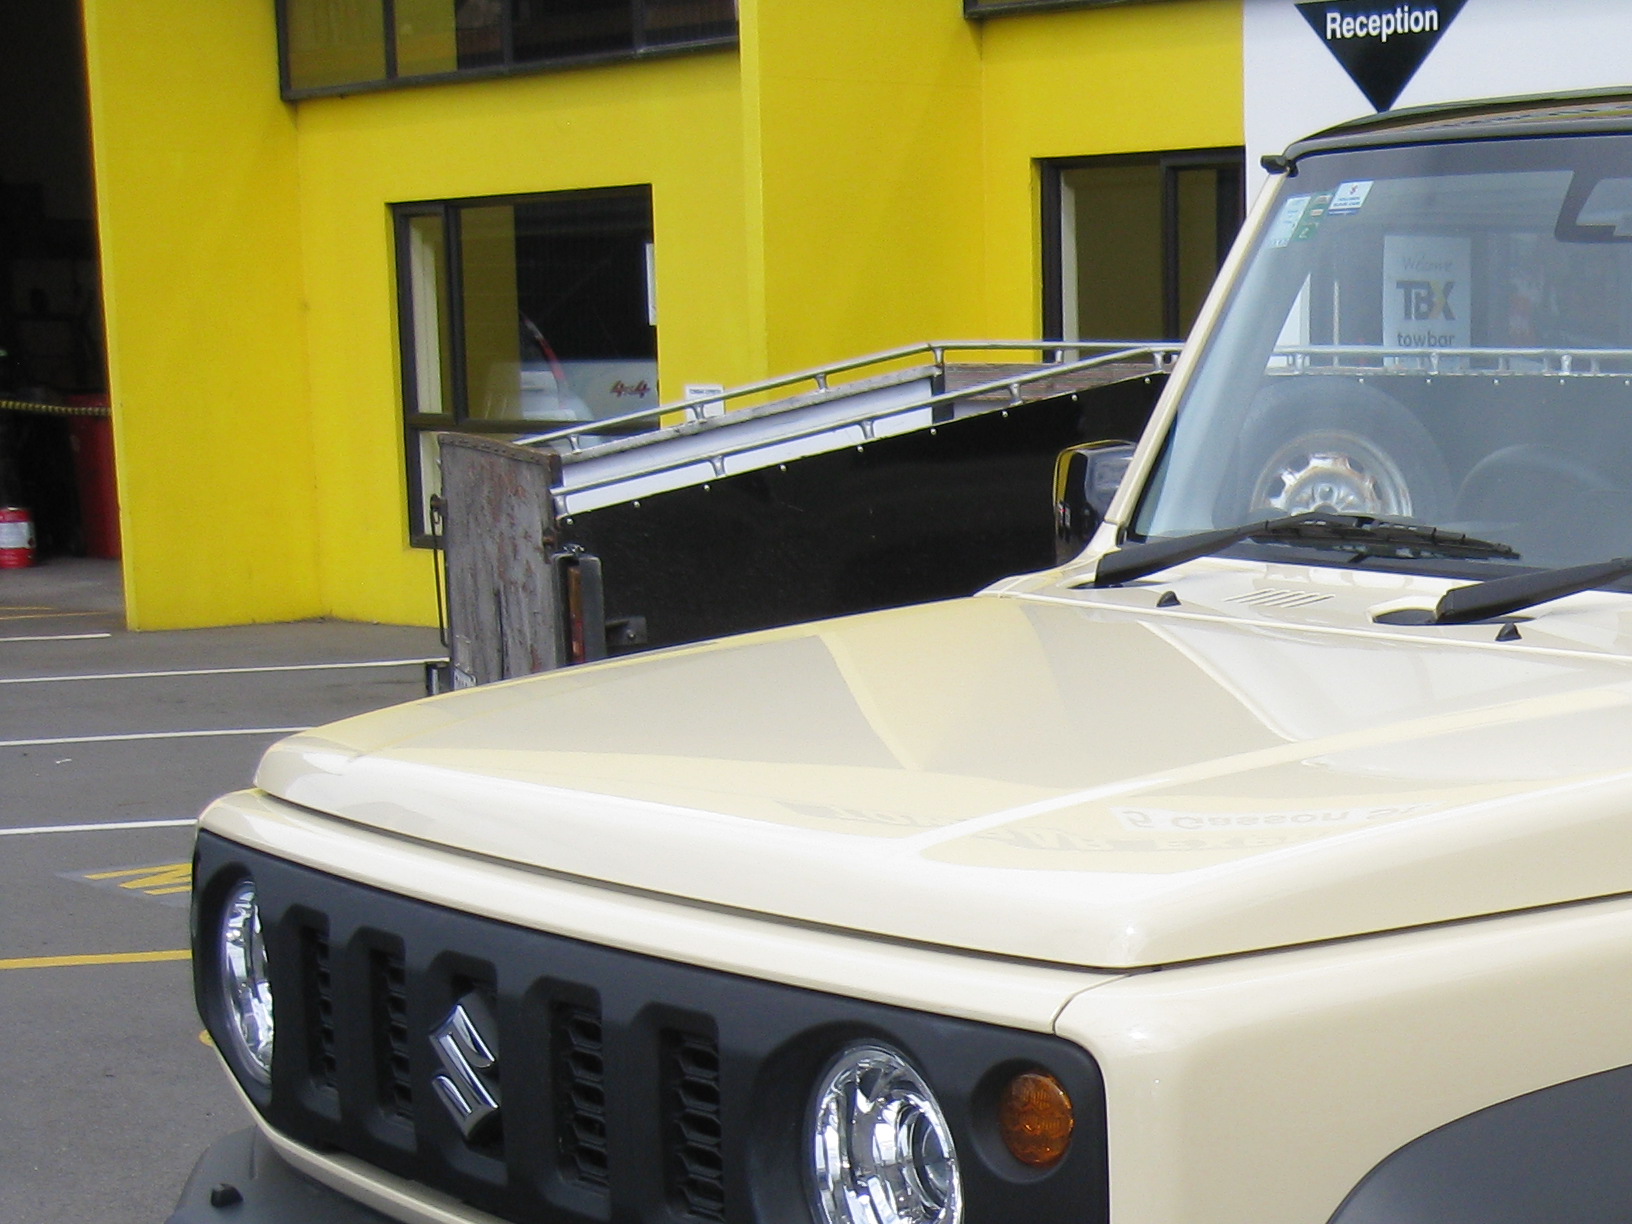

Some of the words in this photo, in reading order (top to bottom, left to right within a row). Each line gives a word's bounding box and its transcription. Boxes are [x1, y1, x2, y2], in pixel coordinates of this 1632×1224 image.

[1326, 5, 1438, 42] Reception
[1396, 280, 1456, 321] TBX
[1397, 330, 1456, 347] towbar
